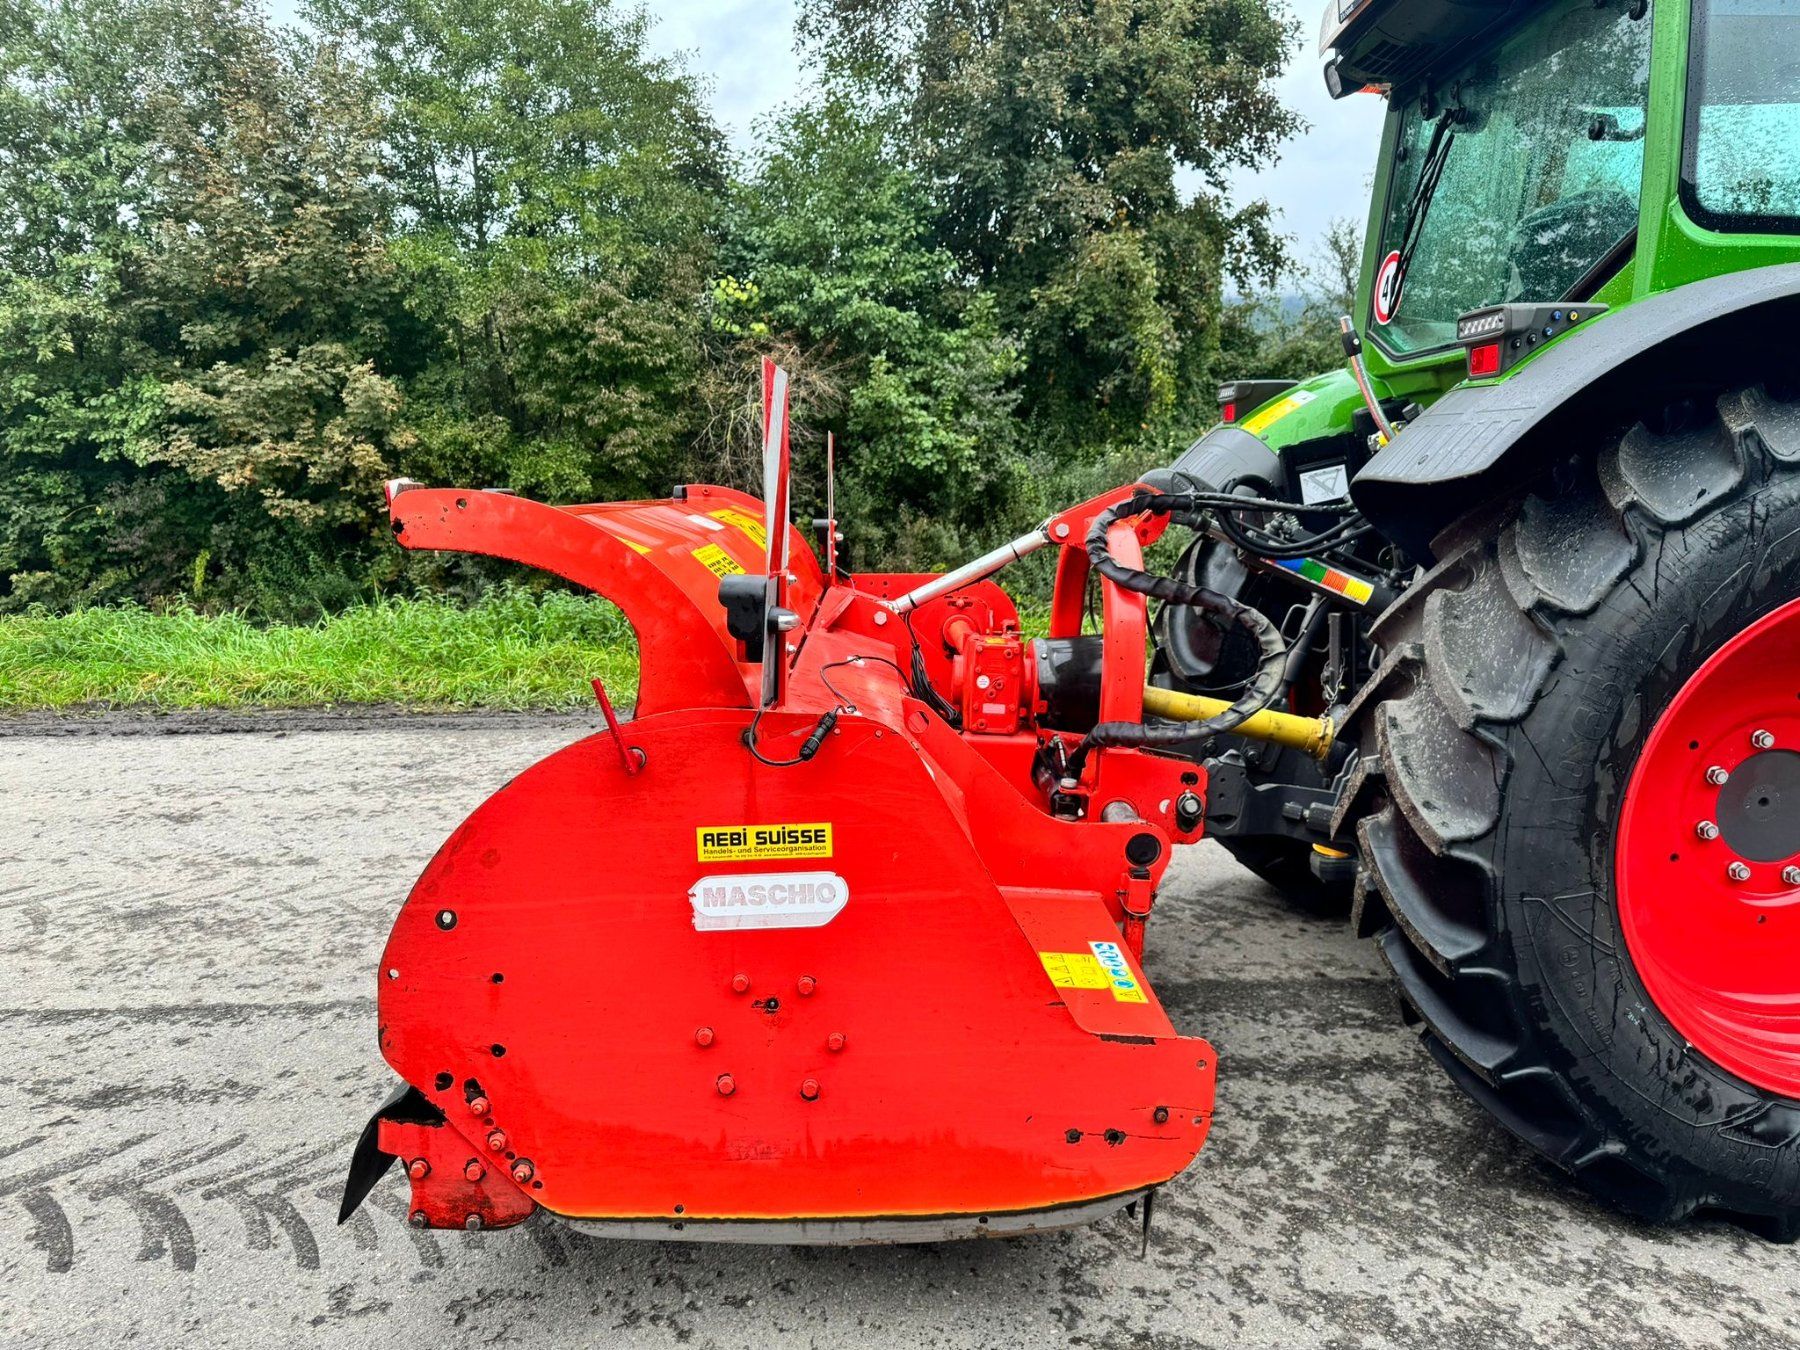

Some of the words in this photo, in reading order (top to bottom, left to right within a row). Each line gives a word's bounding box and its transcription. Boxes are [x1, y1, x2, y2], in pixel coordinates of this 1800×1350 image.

[703, 847, 736, 855] Handels-
[754, 844, 827, 854] Serviceorganisation
[703, 882, 836, 908] MASCHIO
